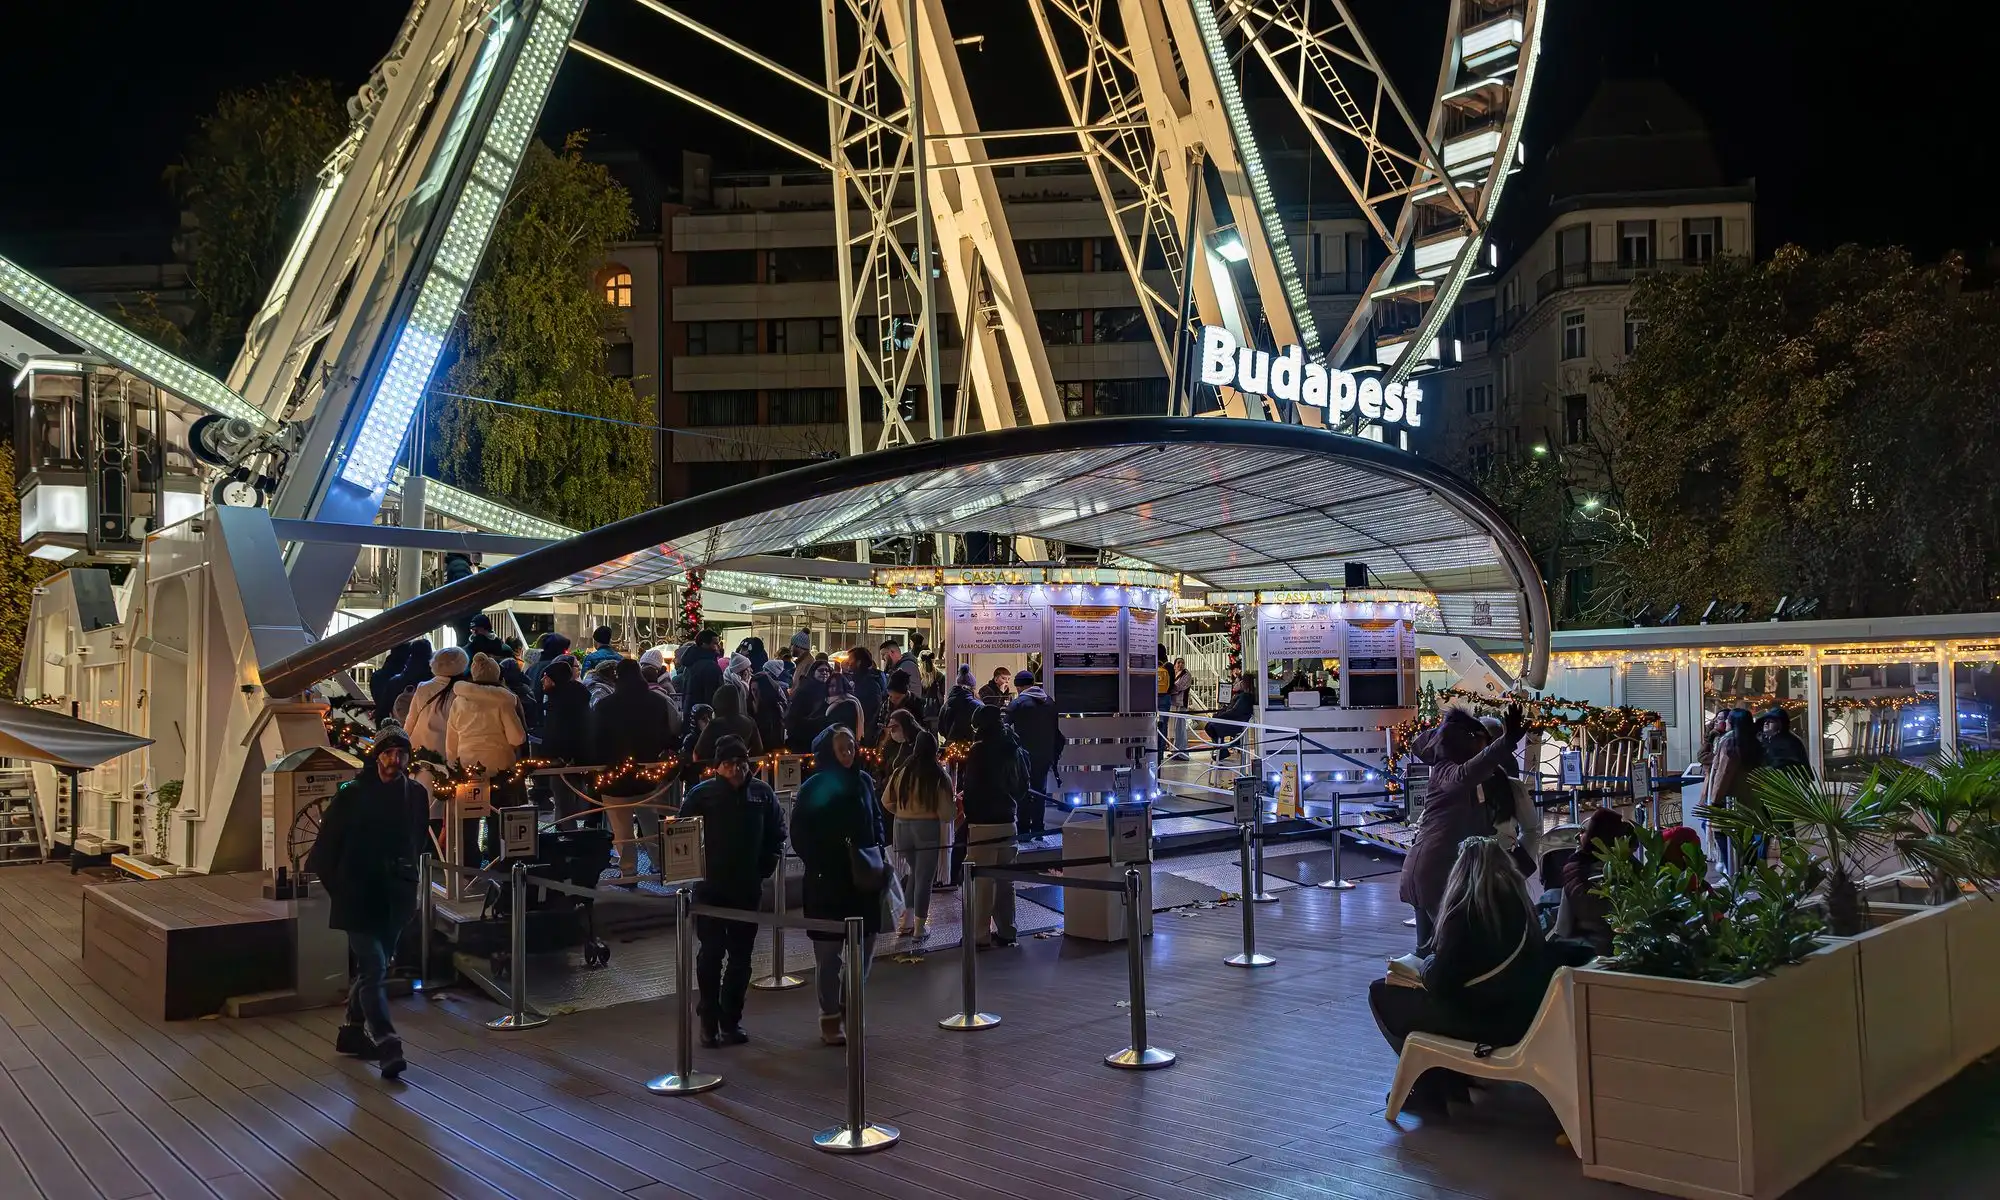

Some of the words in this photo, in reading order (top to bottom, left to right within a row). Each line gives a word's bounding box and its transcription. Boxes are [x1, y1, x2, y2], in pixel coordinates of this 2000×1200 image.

[1201, 325, 1424, 427] Budapest
[962, 571, 1006, 582] CASSA
[1276, 592, 1313, 602] CASSA
[473, 788, 481, 800] P
[518, 825, 527, 840] P
